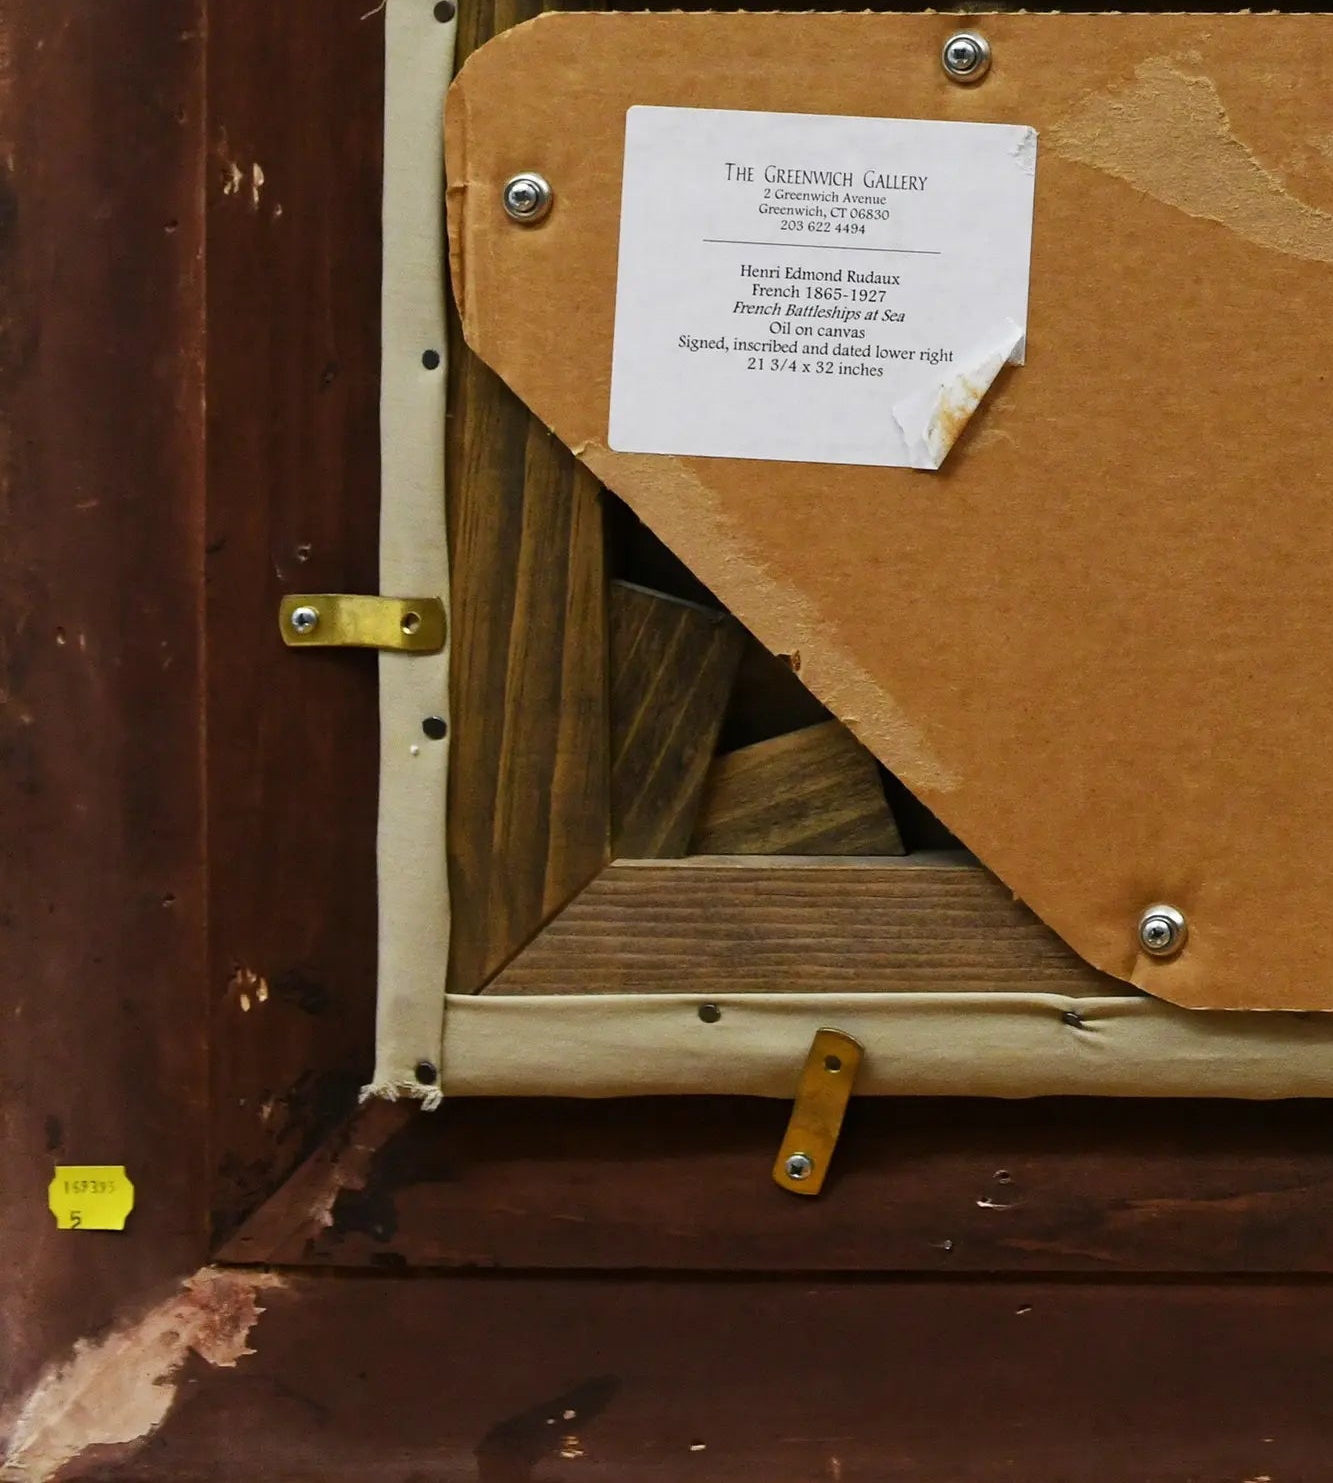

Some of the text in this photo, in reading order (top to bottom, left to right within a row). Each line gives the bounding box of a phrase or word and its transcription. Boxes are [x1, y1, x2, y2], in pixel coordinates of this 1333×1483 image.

[764, 188, 887, 205] 2 Greenwich Avenue
[759, 203, 889, 220] Greenwich, CT 06830
[781, 220, 865, 234] 203 622 4494
[741, 265, 900, 285] Henri Edmond Rudaux
[752, 284, 886, 302] French 1865-1927
[733, 301, 905, 322] French Battleships at Sea
[769, 321, 865, 339] Oil on canvas
[678, 335, 953, 365] Signed, inscribed and dated lower right
[747, 357, 883, 377] 21 3/4 x 32 inches
[70, 1210, 82, 1229] 5
